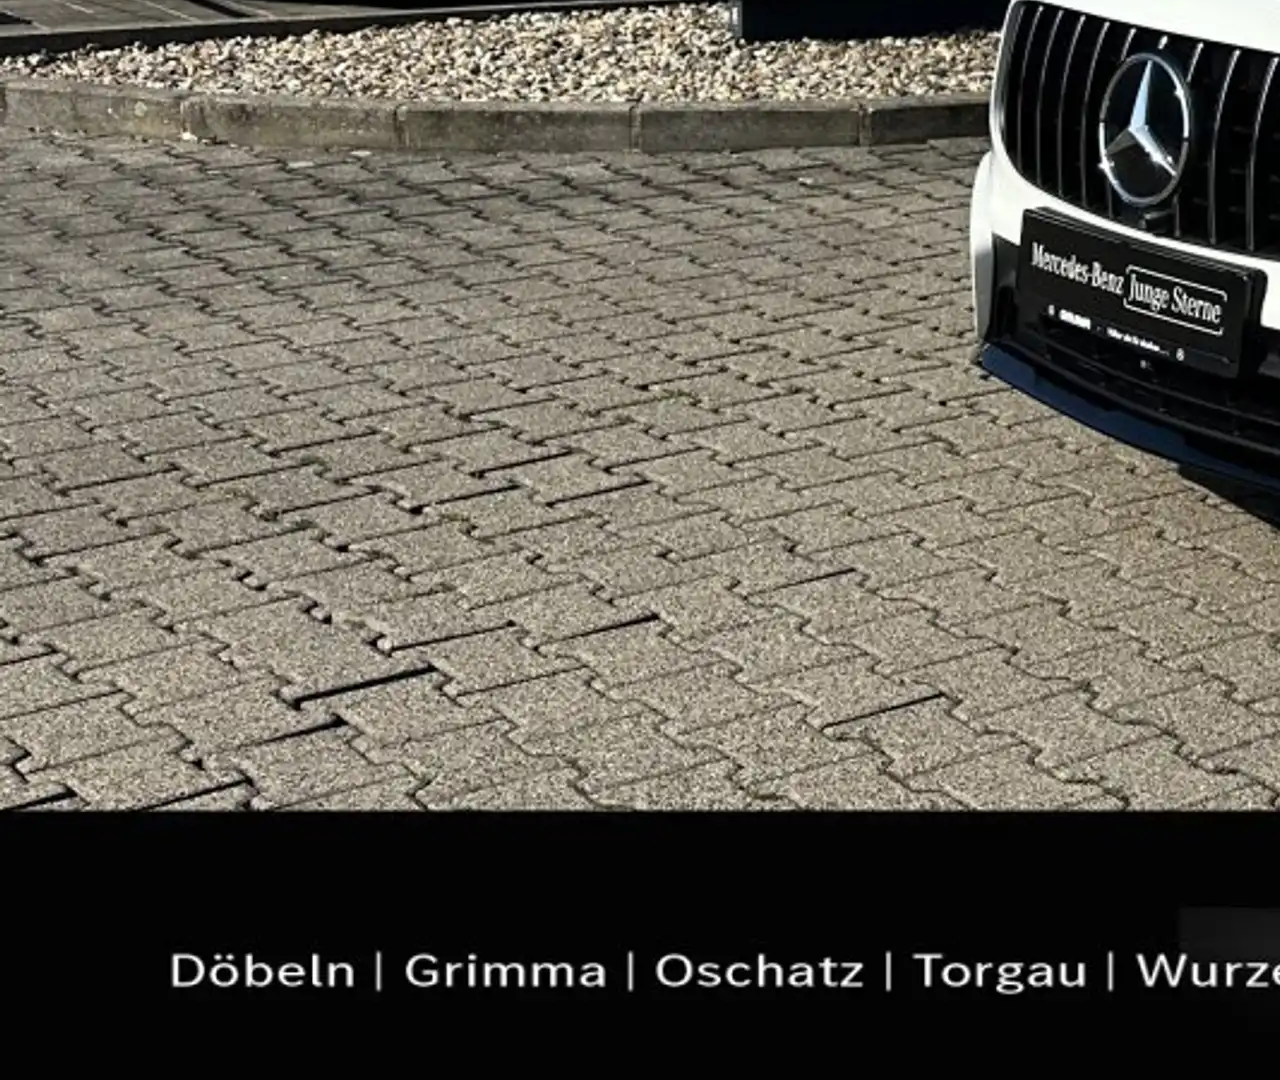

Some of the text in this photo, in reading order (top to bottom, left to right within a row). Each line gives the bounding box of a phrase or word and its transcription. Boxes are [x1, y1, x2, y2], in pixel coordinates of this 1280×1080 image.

[1031, 241, 1222, 325] Mercedes-Benz Junge Sterne
